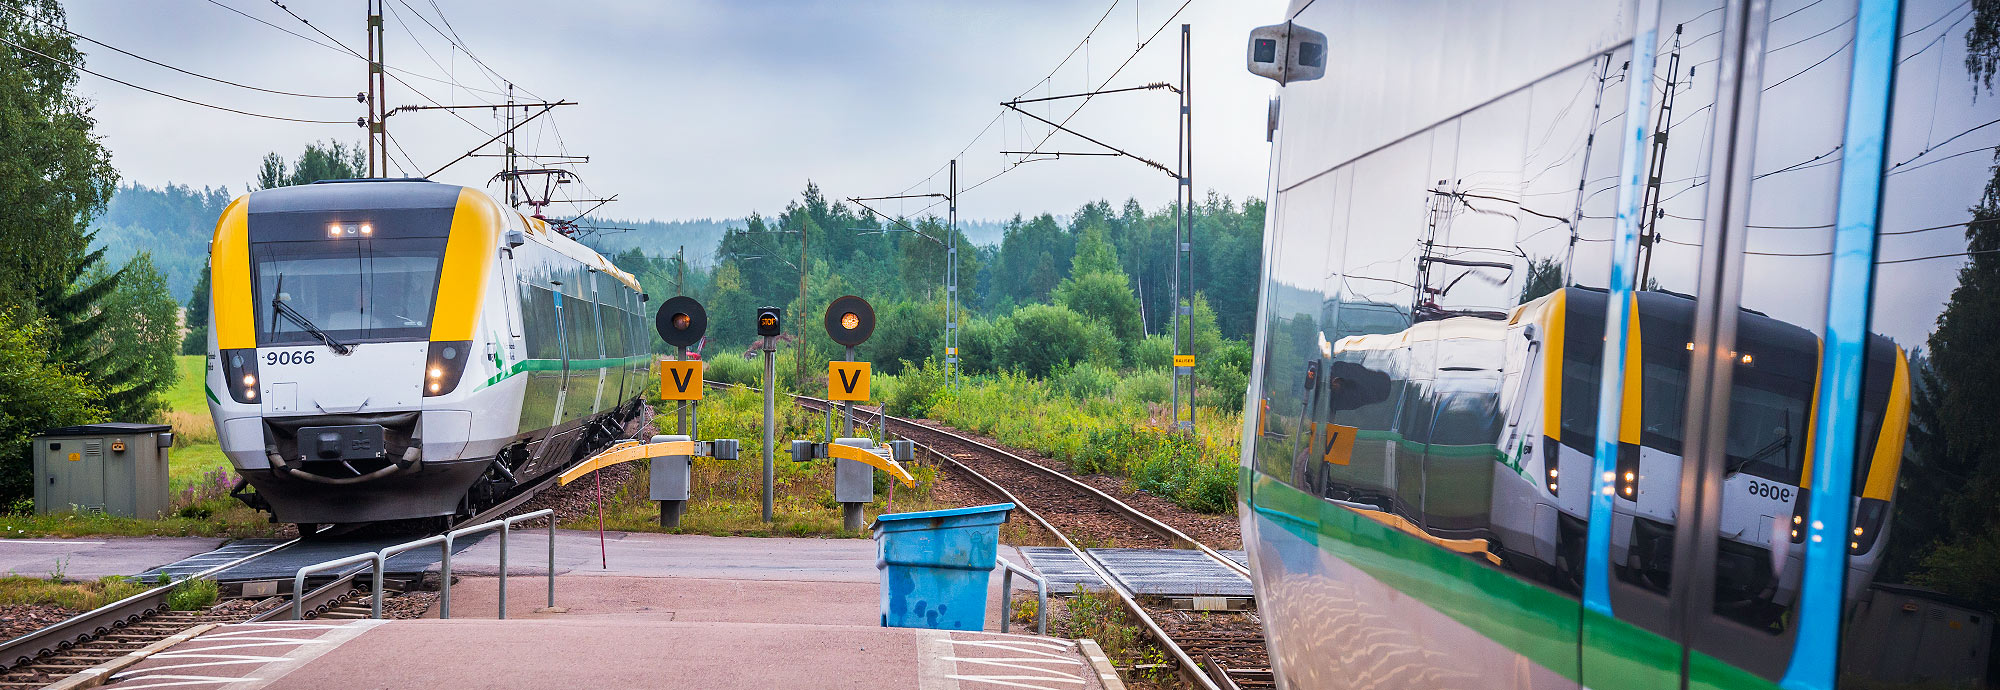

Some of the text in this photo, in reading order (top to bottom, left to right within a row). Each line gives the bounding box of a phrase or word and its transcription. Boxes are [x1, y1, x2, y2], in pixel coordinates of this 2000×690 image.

[761, 318, 776, 326] STOP
[267, 351, 315, 365] 9066
[670, 368, 694, 393] V
[837, 369, 862, 394] V
